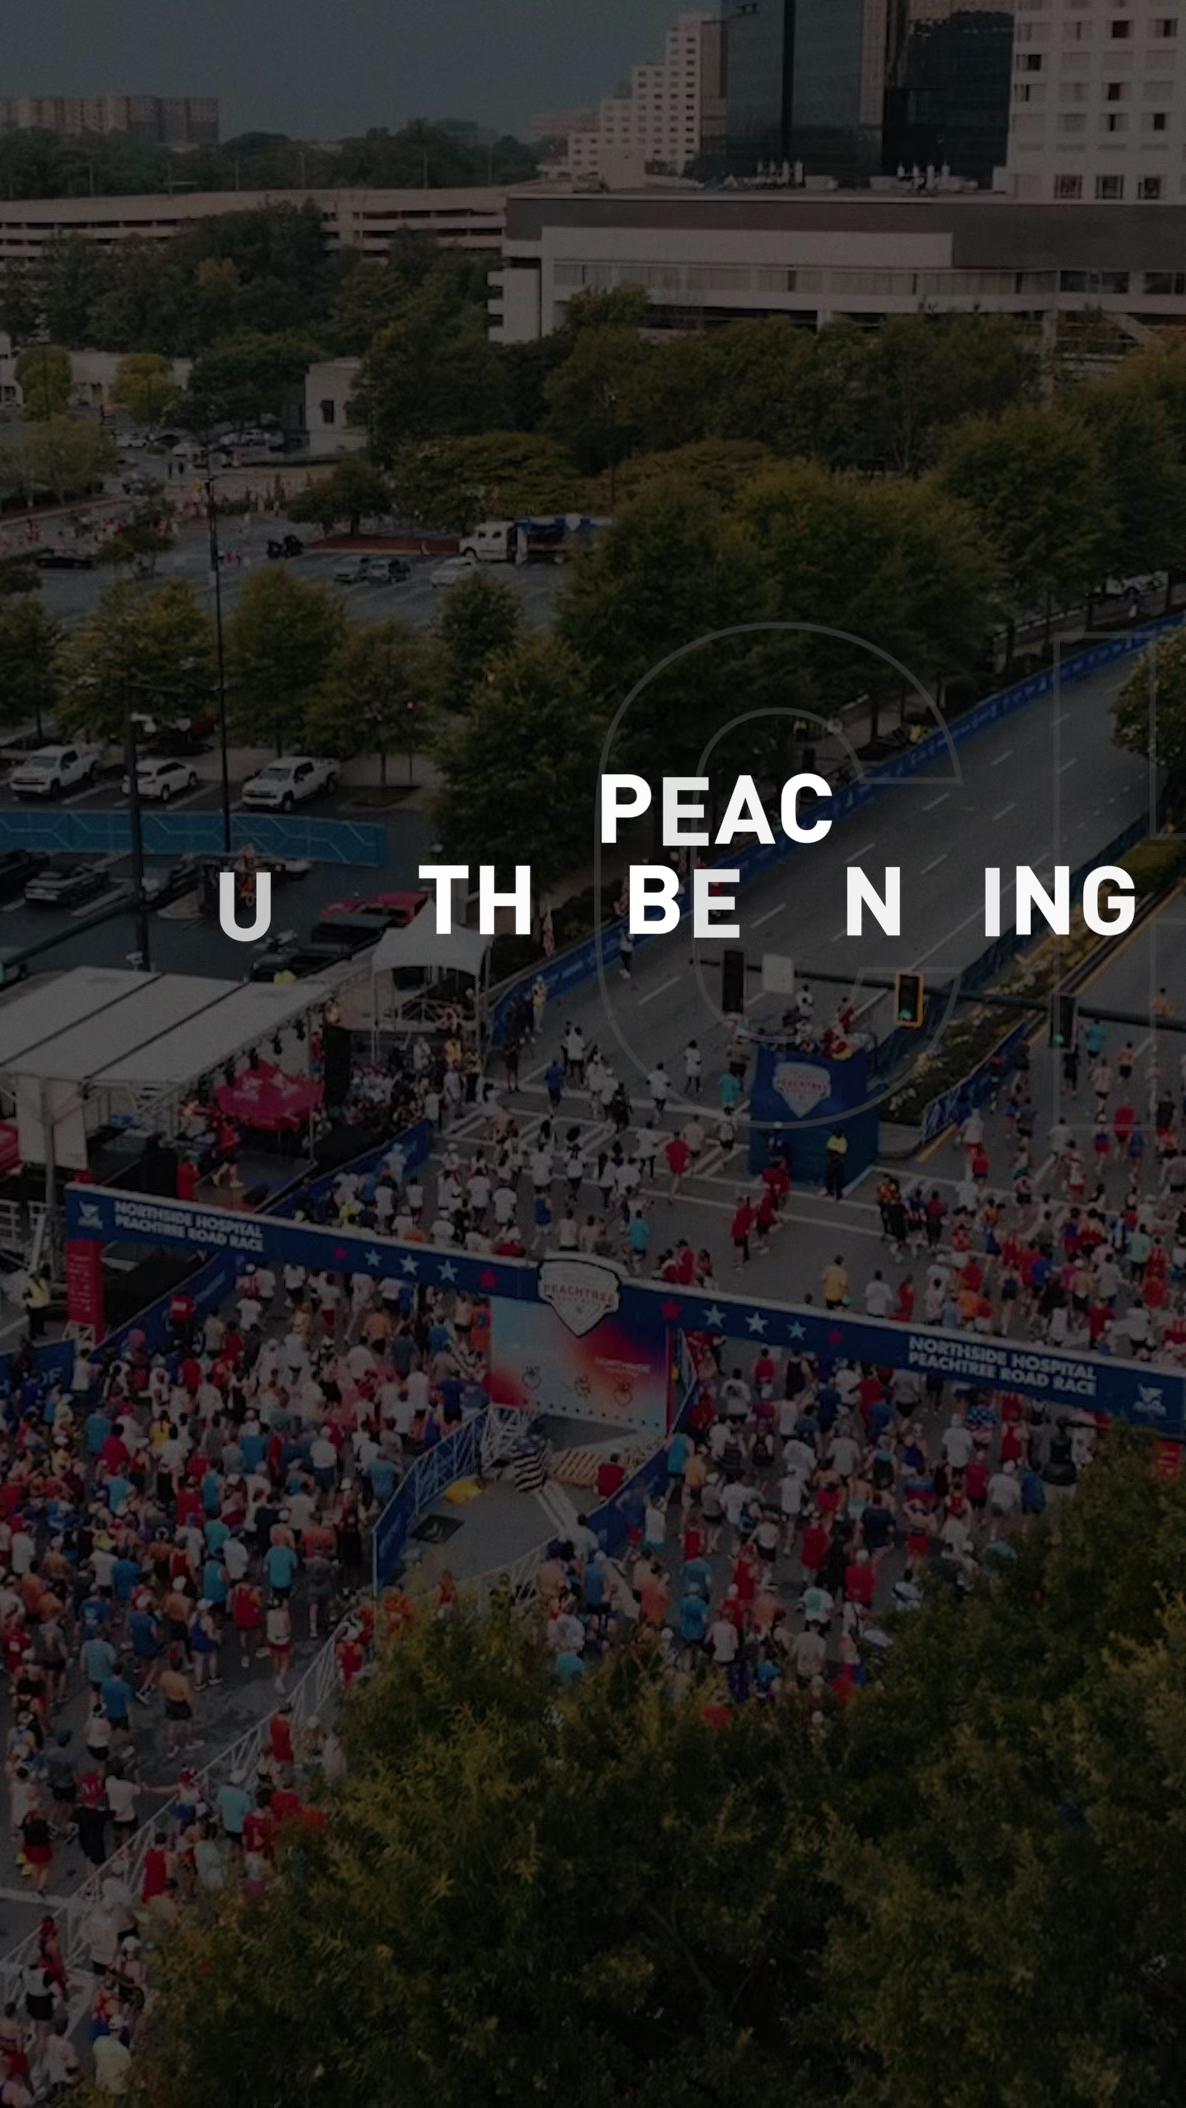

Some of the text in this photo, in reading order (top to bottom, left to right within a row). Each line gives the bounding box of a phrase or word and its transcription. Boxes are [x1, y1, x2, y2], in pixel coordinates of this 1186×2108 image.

[114, 1200, 264, 1239] NORTHSIDE HOSPITAL
[114, 1214, 264, 1252] PEACHTREE ROAD RACE
[908, 1335, 1098, 1381] NORTHSIDE HOSPITAL
[908, 1350, 1098, 1396] PEACHTREE ROAD RACE
